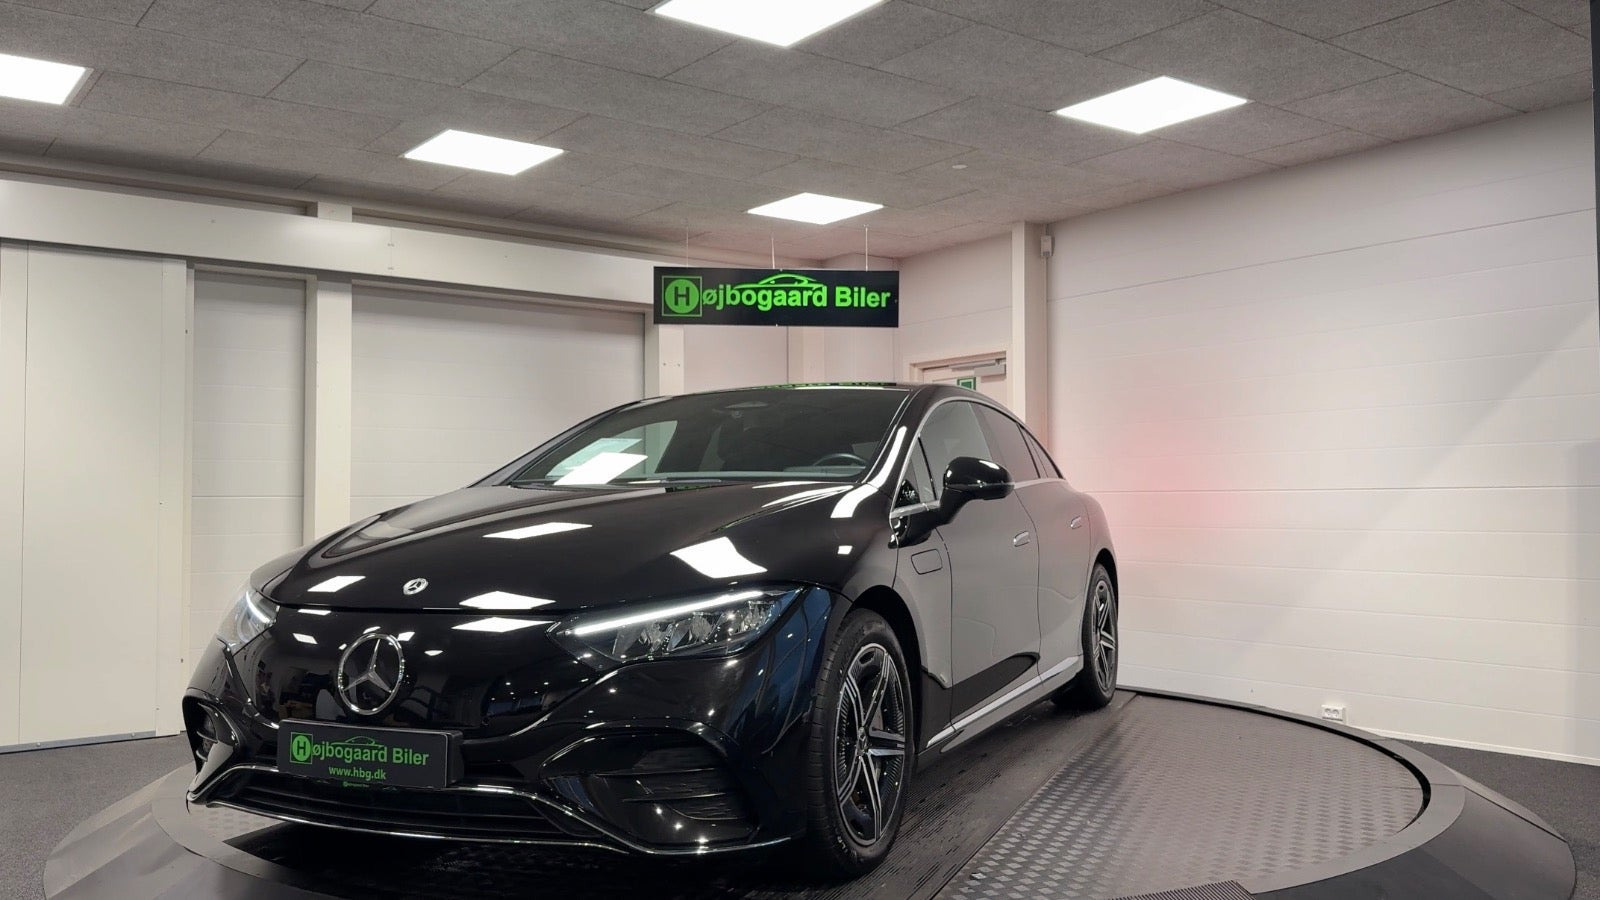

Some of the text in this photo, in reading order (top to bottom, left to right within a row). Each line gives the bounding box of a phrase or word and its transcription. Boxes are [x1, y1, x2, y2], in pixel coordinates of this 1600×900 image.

[671, 284, 892, 311] Højbogaard Biler
[295, 739, 430, 766] Højbogaard Biler
[328, 765, 387, 781] www.hbg.dk
